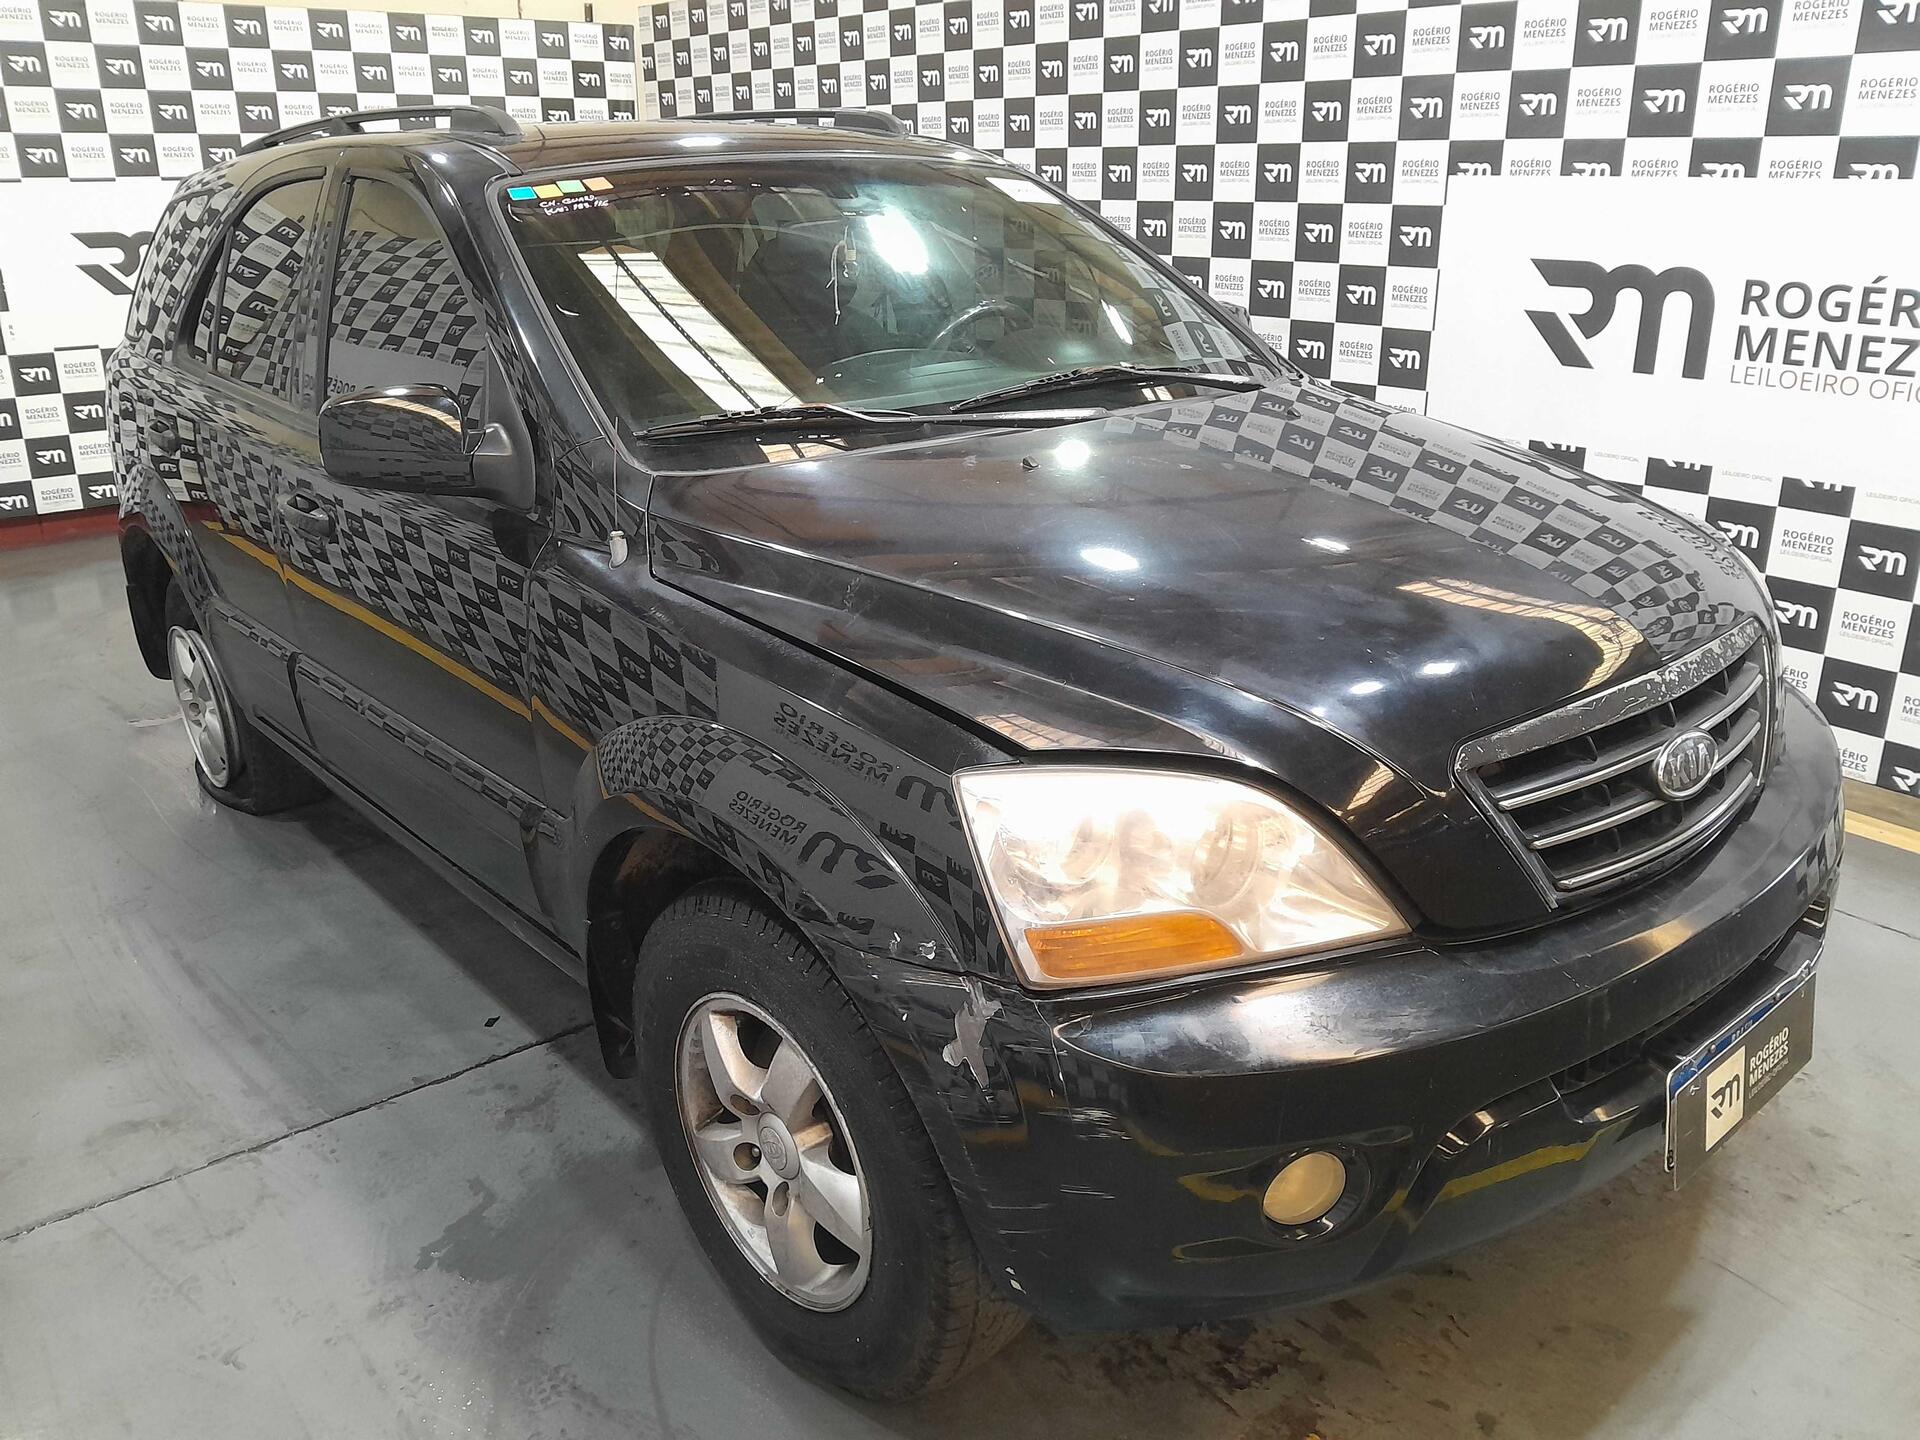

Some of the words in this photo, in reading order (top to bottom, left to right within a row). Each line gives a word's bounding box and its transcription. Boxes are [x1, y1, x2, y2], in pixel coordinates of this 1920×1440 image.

[1040, 2, 1064, 12] ROGÉRIO
[1109, 2, 1136, 12] MENEZES
[976, 10, 999, 20] ROGÉRIO
[1040, 11, 1064, 20] MENEZES
[1650, 8, 1698, 21] ROGÉRIO
[1793, 9, 1848, 22] MENEZES
[976, 18, 999, 27] MENEZES
[1524, 16, 1567, 29] ROGÉRIO
[1649, 20, 1697, 32] MENEZES
[1413, 25, 1451, 37] ROGÉRIO
[1523, 28, 1566, 39] MENEZES
[1313, 33, 1348, 44] ROGÉRIO
[1412, 35, 1450, 46] MENEZES
[1225, 40, 1256, 51] ROGÉRIO
[1313, 43, 1347, 54] MENEZES
[1145, 47, 1173, 58] ROGÉRIO
[1225, 50, 1255, 60] MENEZES
[1073, 53, 1098, 63] ROGÉRIO
[1145, 56, 1173, 66] MENEZES
[948, 64, 969, 73] ROGÉRIO
[1008, 59, 1031, 68] ROGÉRIO
[1073, 62, 1098, 71] MENEZES
[1860, 75, 1918, 88] ROGÉRIO
[1577, 86, 1622, 97] ROGÉRIO
[1709, 81, 1760, 94] ROGÉRIO
[1461, 90, 1500, 101] ROGÉRIO
[1707, 94, 1758, 104] MENEZES
[1858, 88, 1917, 100] MENEZES
[1265, 98, 1297, 109] ROGÉRIO
[1357, 94, 1393, 105] ROGÉRIO
[1576, 98, 1621, 107] MENEZES
[1107, 106, 1134, 116] ROGÉRIO
[1182, 102, 1211, 112] ROGÉRIO
[1357, 105, 1392, 114] MENEZES
[1460, 101, 1500, 111] MENEZES
[978, 112, 1000, 121] ROGÉRIO
[1039, 109, 1063, 118] ROGÉRIO
[1182, 112, 1211, 120] MENEZES
[1265, 109, 1296, 117] MENEZES
[1072, 161, 1097, 170] ROGÉRIO
[1142, 160, 1170, 169] ROGÉRIO
[1220, 159, 1250, 169] ROGÉRIO
[1306, 158, 1339, 168] ROGÉRIO
[1402, 158, 1439, 168] ROGÉRIO
[1510, 158, 1552, 169] ROGÉRIO
[1632, 158, 1679, 169] ROGÉRIO
[1769, 158, 1823, 170] ROGÉRIO
[1178, 216, 1207, 225] ROGÉRIO
[1259, 218, 1290, 228] ROGÉRIO
[1348, 220, 1383, 230] ROGÉRIO
[1259, 227, 1290, 236] MENEZES
[1348, 230, 1383, 239] MENEZES
[1215, 273, 1244, 283] ROGÉRIO
[1298, 278, 1331, 288] ROGÉRIO
[1215, 282, 1243, 291] MENEZES
[1392, 284, 1428, 295] ROGÉRIO
[1298, 287, 1331, 297] MENEZES
[1391, 293, 1428, 304] MENEZES
[1339, 340, 1373, 351] ROGÉRIO
[1339, 348, 1373, 359] MENEZES
[1730, 365, 1859, 396] LEILOEIRO
[1783, 528, 1834, 546] ROGÉRIO
[1781, 538, 1833, 556] MENEZES
[1842, 610, 1896, 630] ROGÉRIO
[1841, 620, 1895, 640] MENEZES
[1750, 1027, 1789, 1072] ROGÉRIO
[1749, 1040, 1789, 1087] MENEZES
